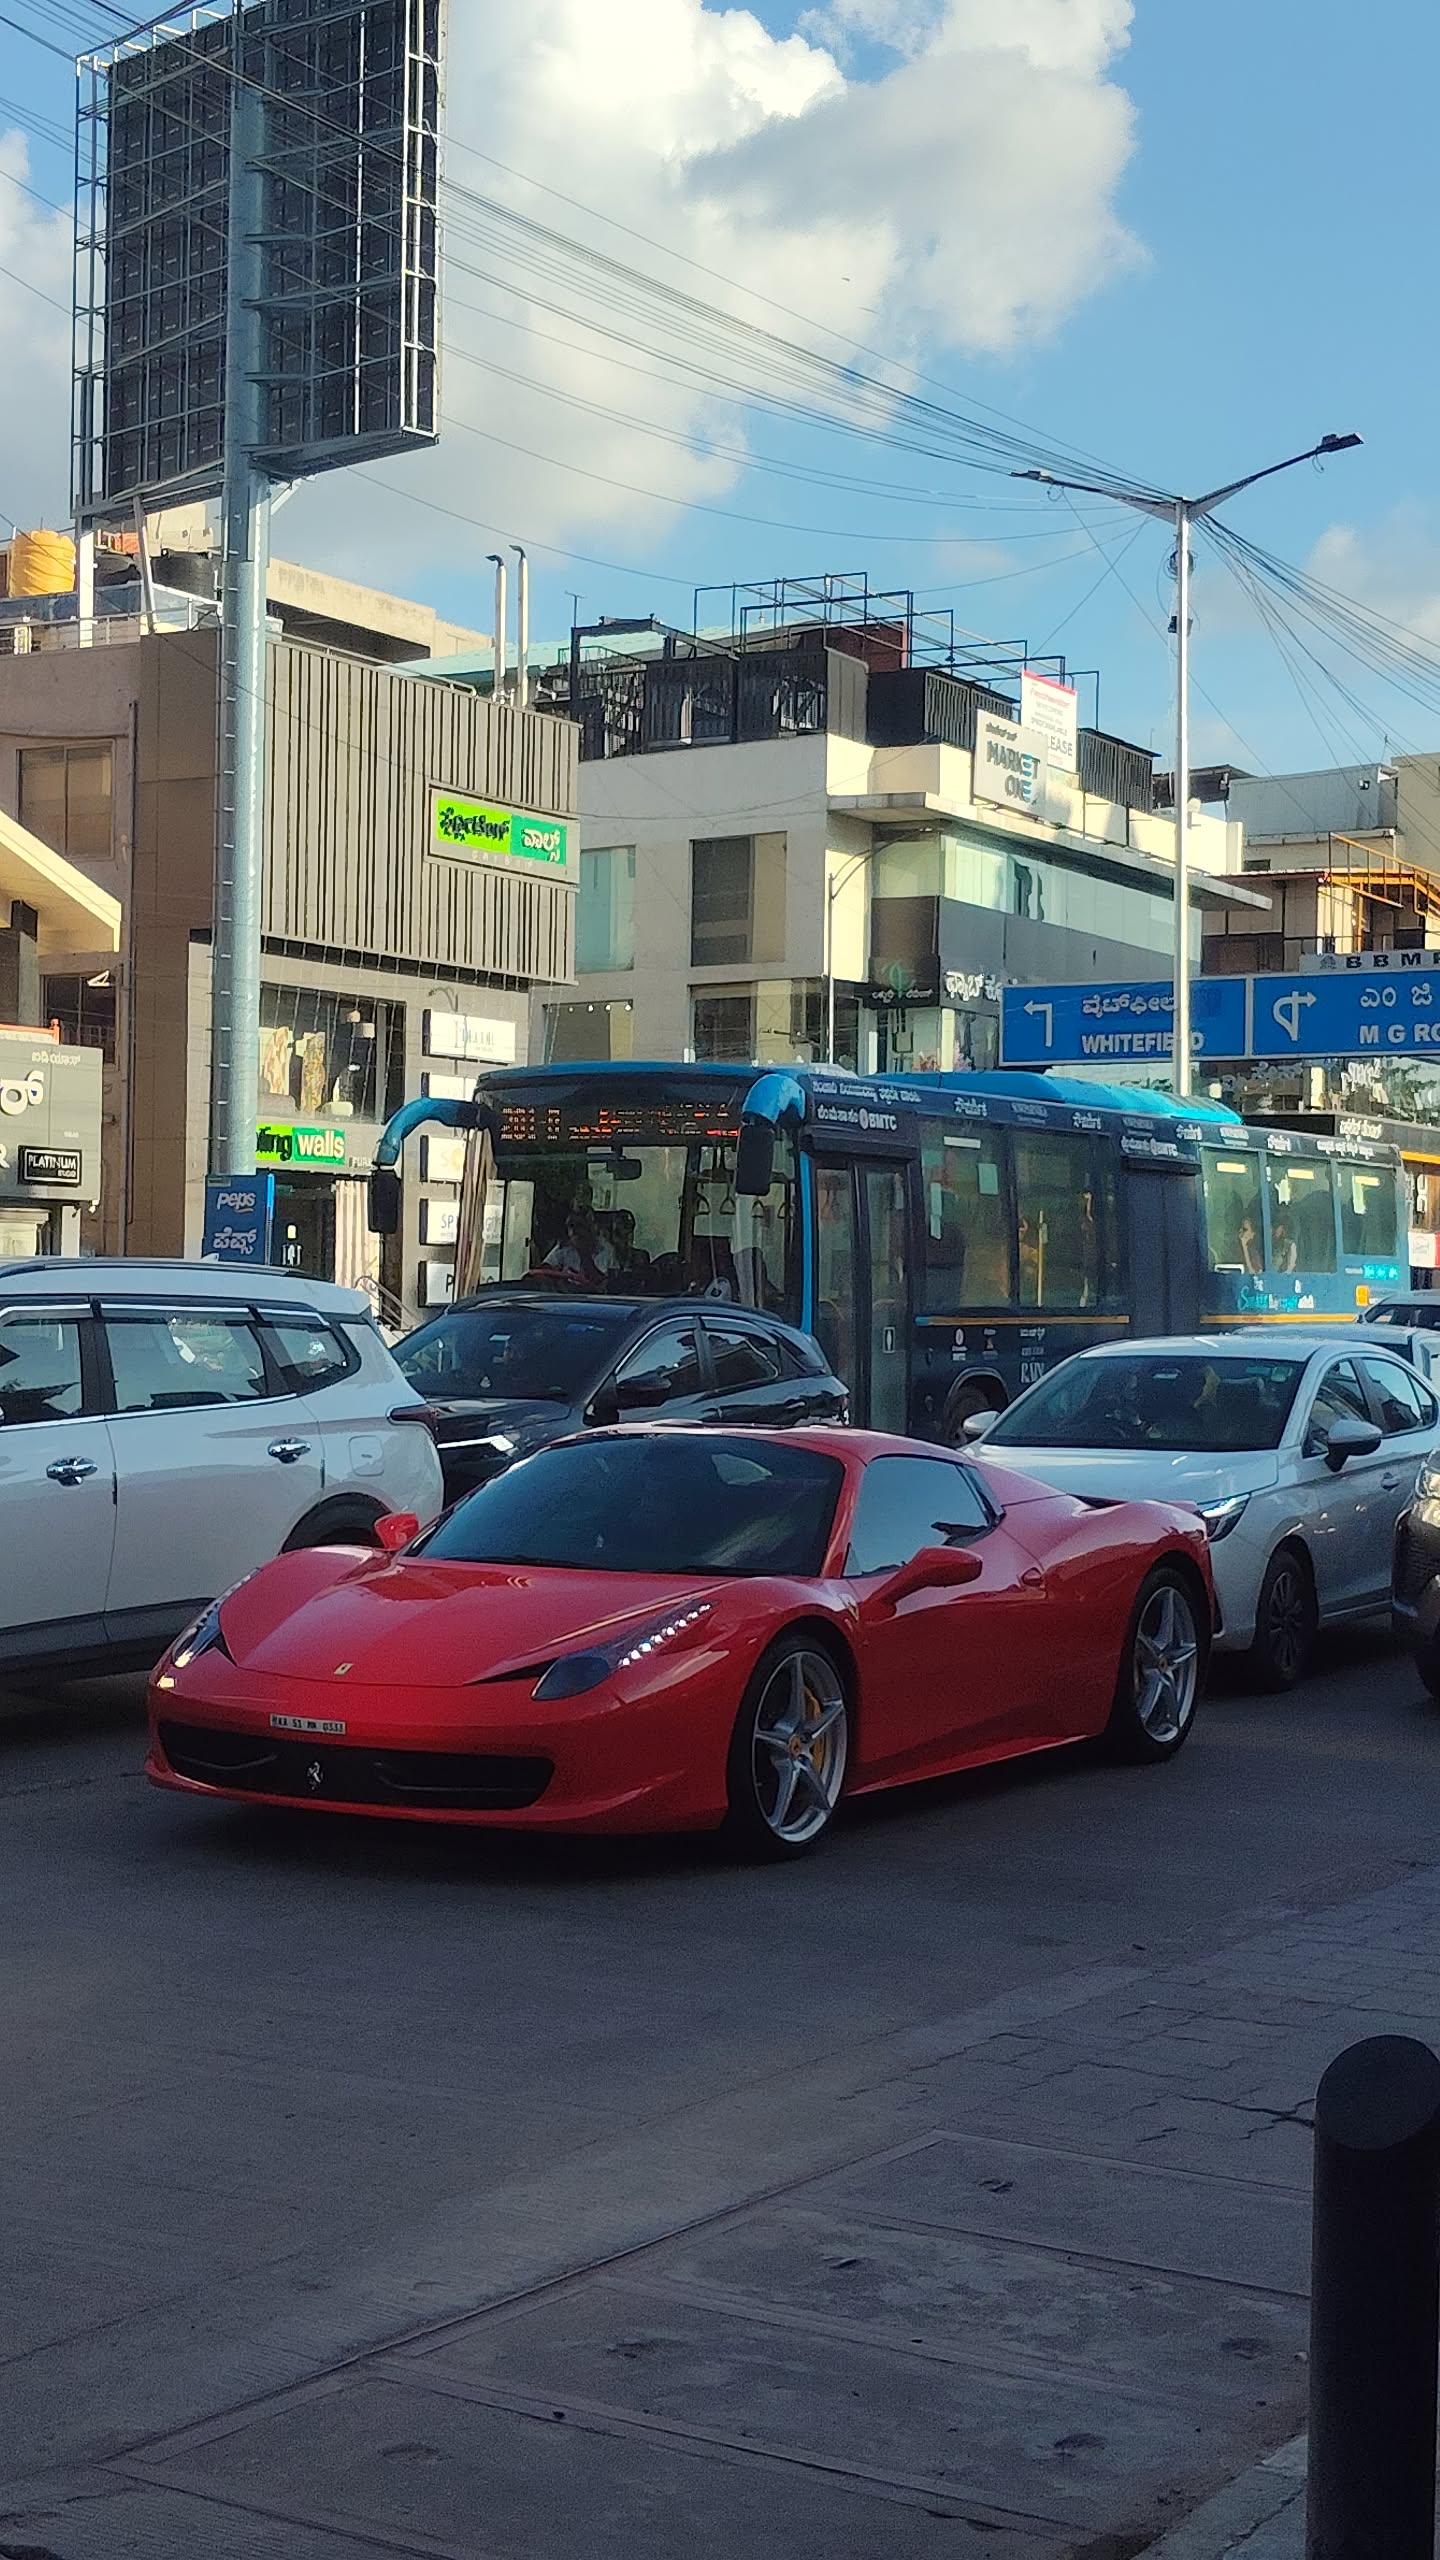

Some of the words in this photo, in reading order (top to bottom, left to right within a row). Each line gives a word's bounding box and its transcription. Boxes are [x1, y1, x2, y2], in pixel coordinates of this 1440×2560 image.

[1048, 734, 1073, 757] EASE
[986, 740, 1040, 779] MARKET
[1082, 1031, 1205, 1054] WHITEFIED
[1359, 1024, 1380, 1044] M
[1387, 1023, 1406, 1044] G
[868, 1112, 898, 1131] BMTC
[298, 1130, 345, 1158] walls
[28, 1153, 77, 1171] PLATINUM
